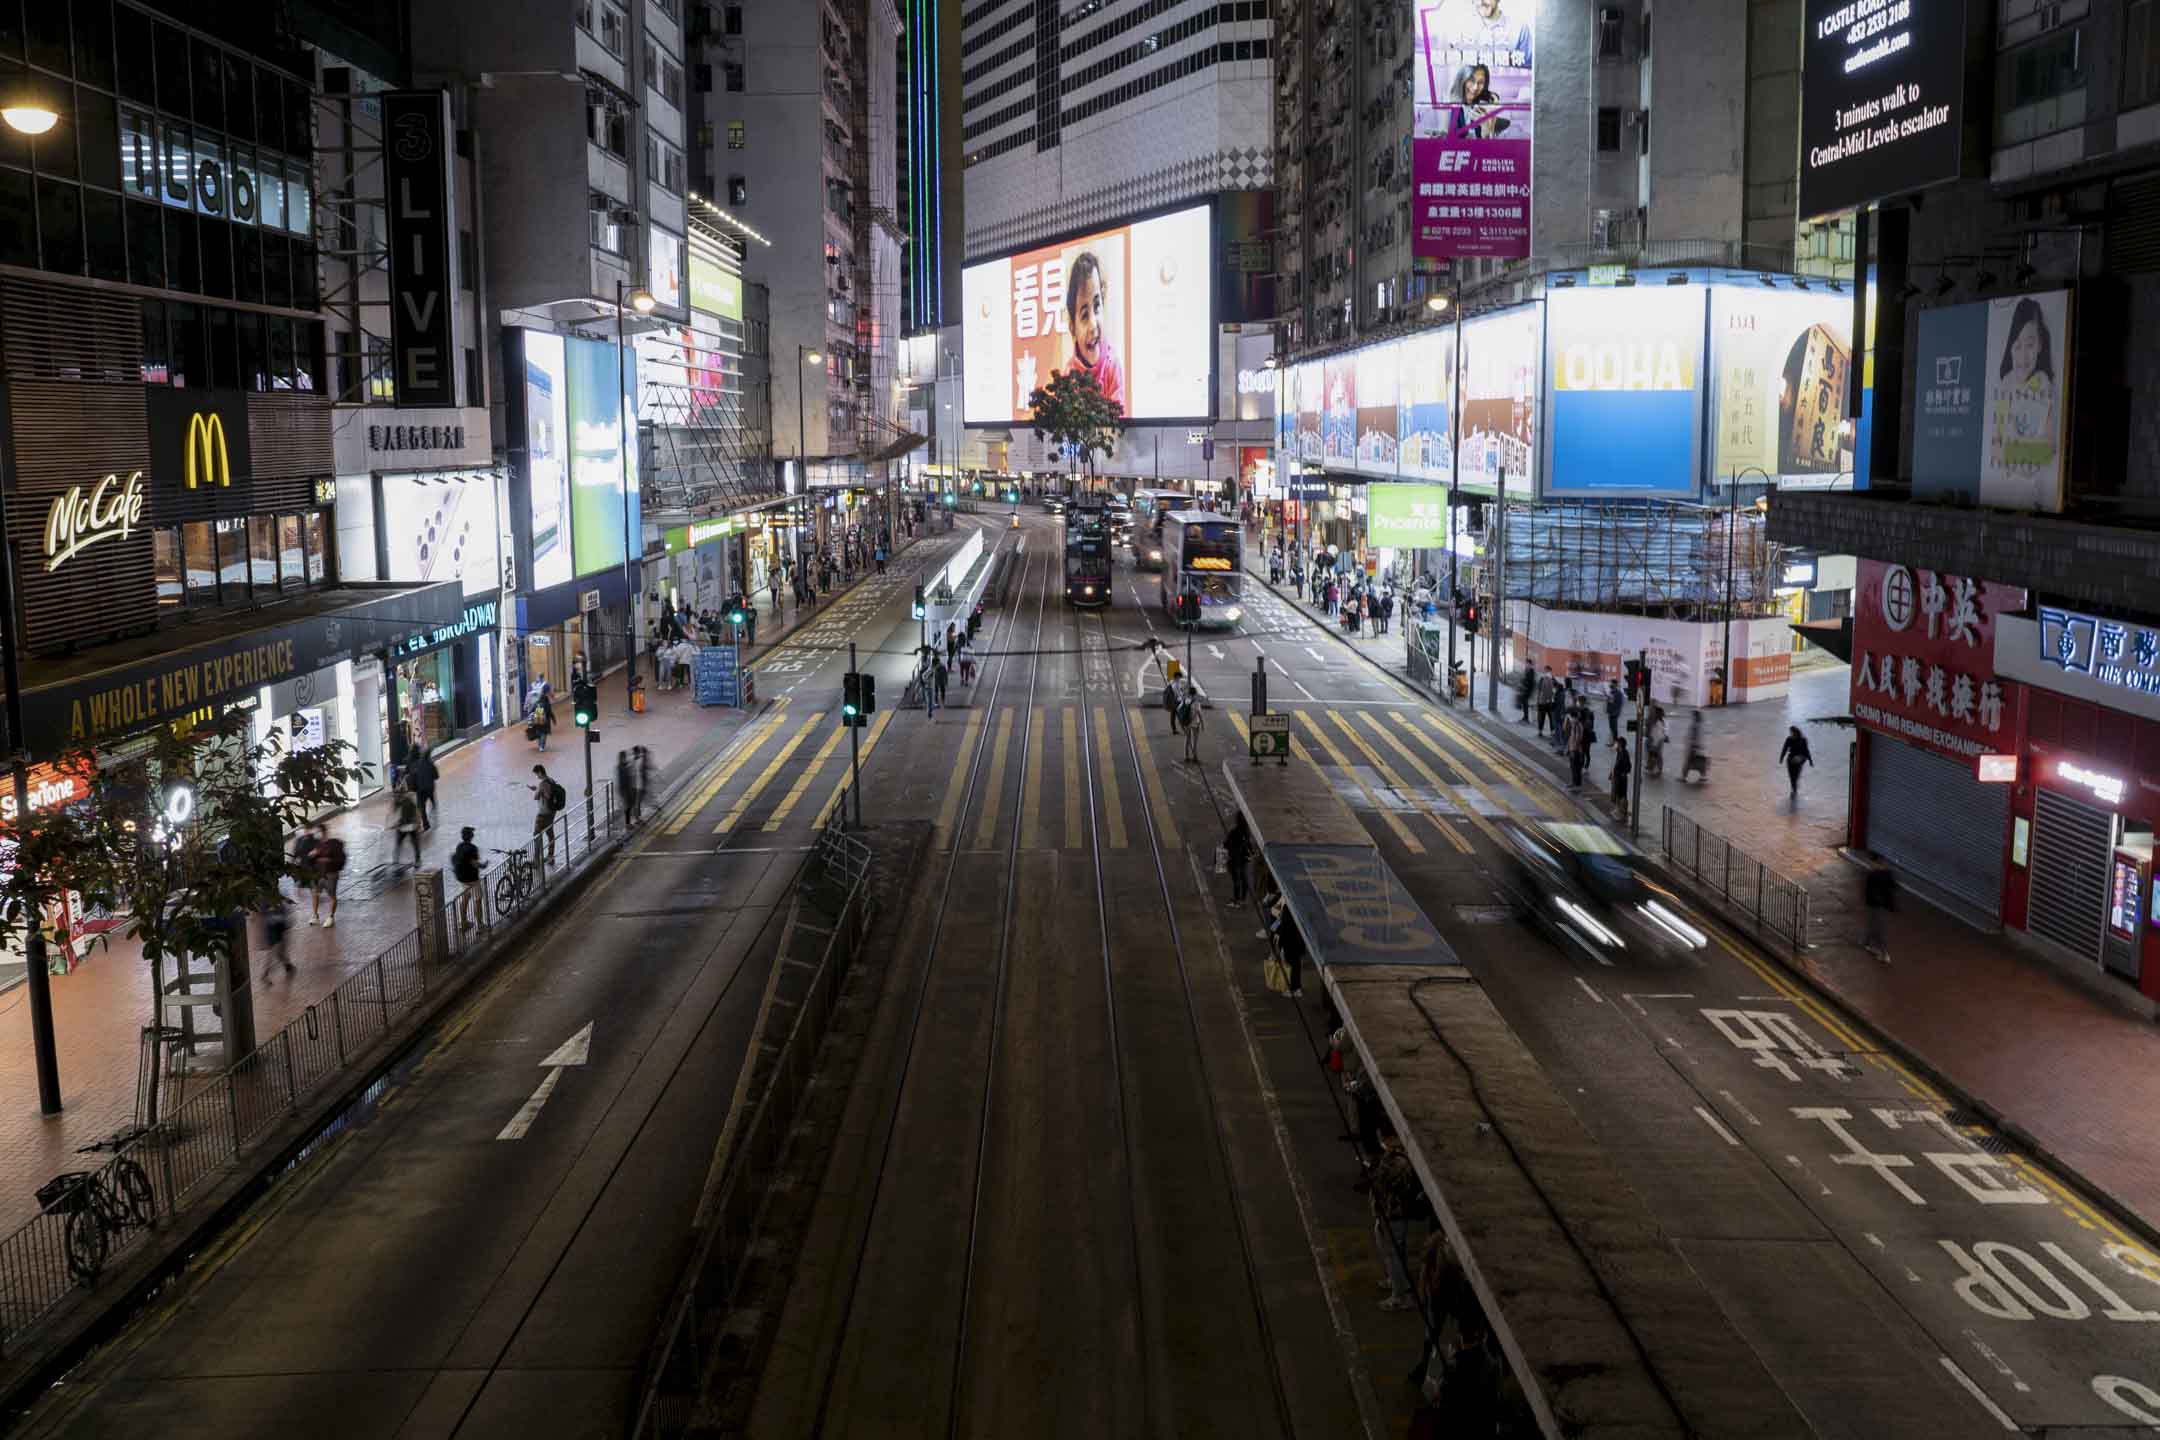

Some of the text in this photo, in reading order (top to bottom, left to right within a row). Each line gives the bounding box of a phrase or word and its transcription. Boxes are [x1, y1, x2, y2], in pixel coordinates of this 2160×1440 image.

[1824, 4, 1856, 36] CASTLE
[1866, 9, 1888, 37] 2533
[1834, 82, 1920, 132] 3 minutes walk to
[1438, 149, 1472, 172] EF
[1810, 104, 1950, 169] Central-Mid Levels escalator
[45, 470, 144, 560] McCafé
[1920, 568, 1979, 649] 中英
[71, 699, 86, 739] A
[88, 678, 157, 733] WHOLE
[162, 663, 199, 711] NEW
[204, 639, 295, 696] EXPERIENCE
